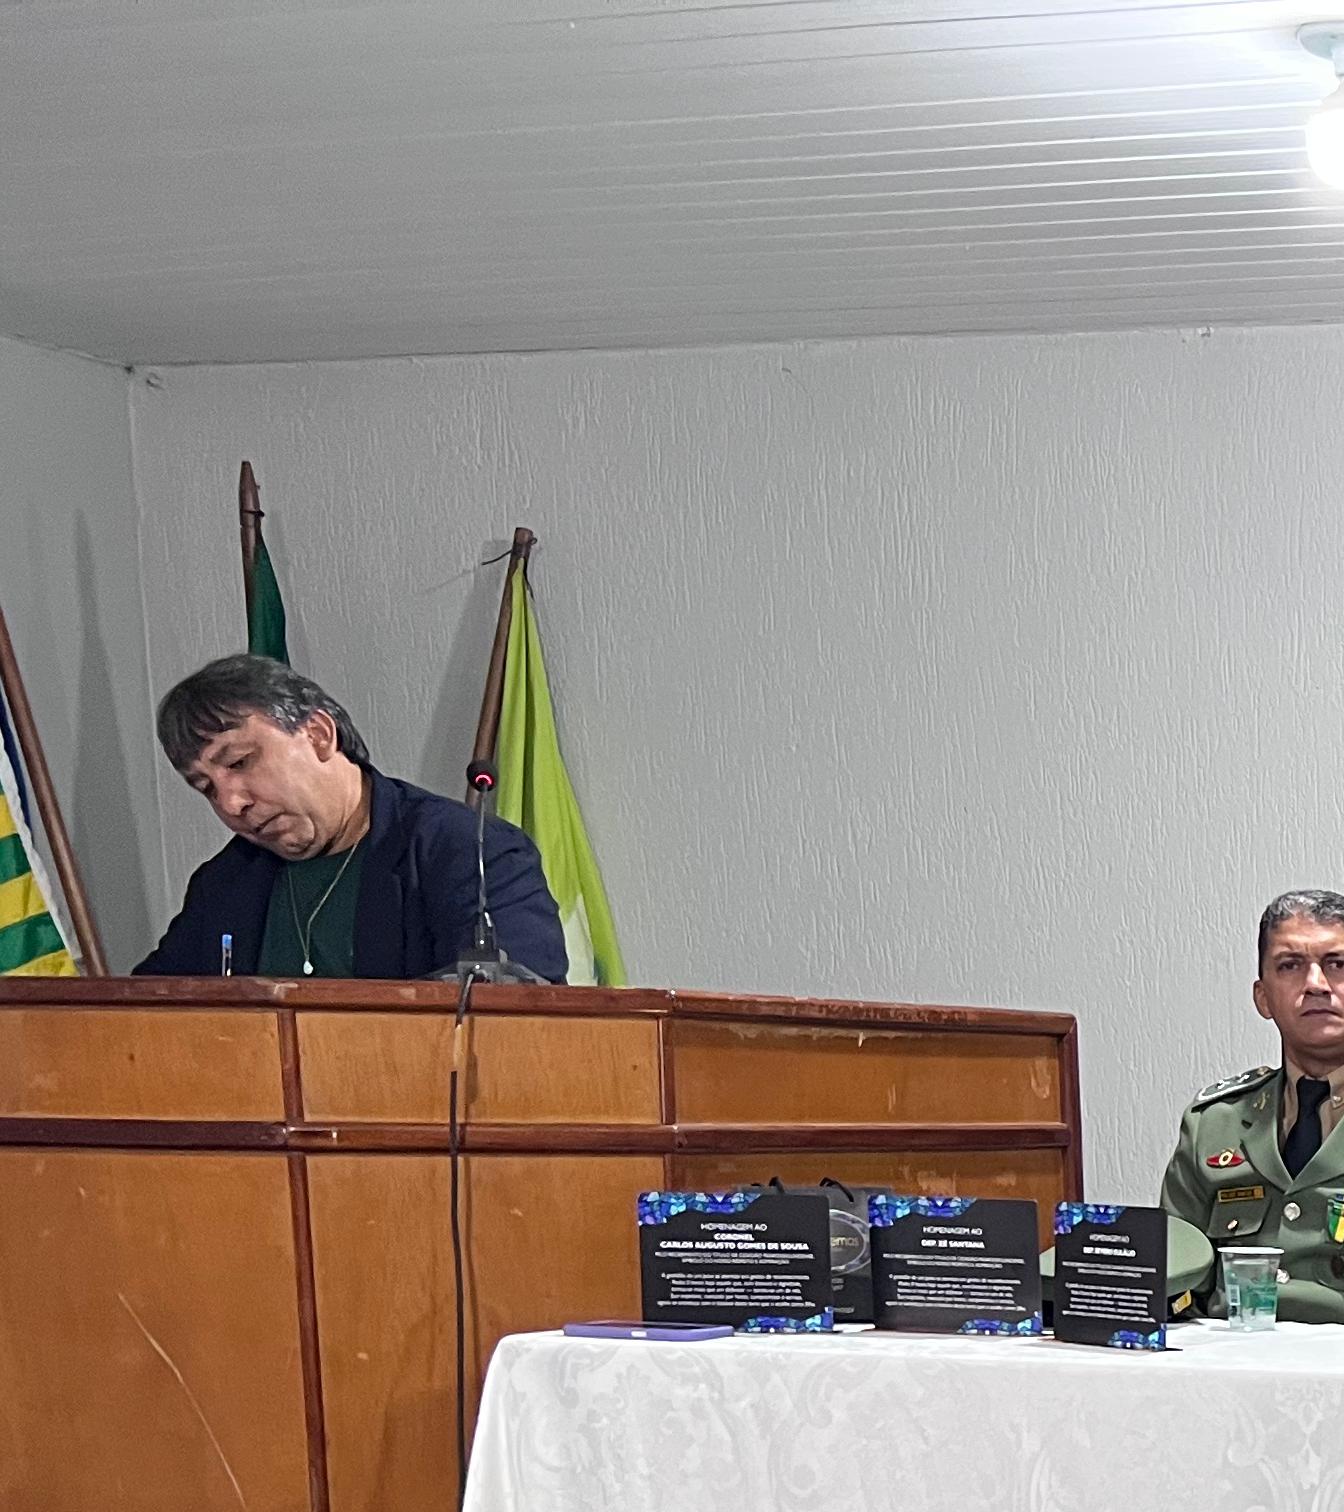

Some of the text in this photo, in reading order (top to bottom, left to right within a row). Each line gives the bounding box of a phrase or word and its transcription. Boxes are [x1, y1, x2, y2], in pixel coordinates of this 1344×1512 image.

[700, 1222, 768, 1232] HOMENAGEM AO
[713, 1233, 755, 1241] CORONEL
[659, 1241, 810, 1251] CARLOS AUGUSTO GOMES DE SOUSA
